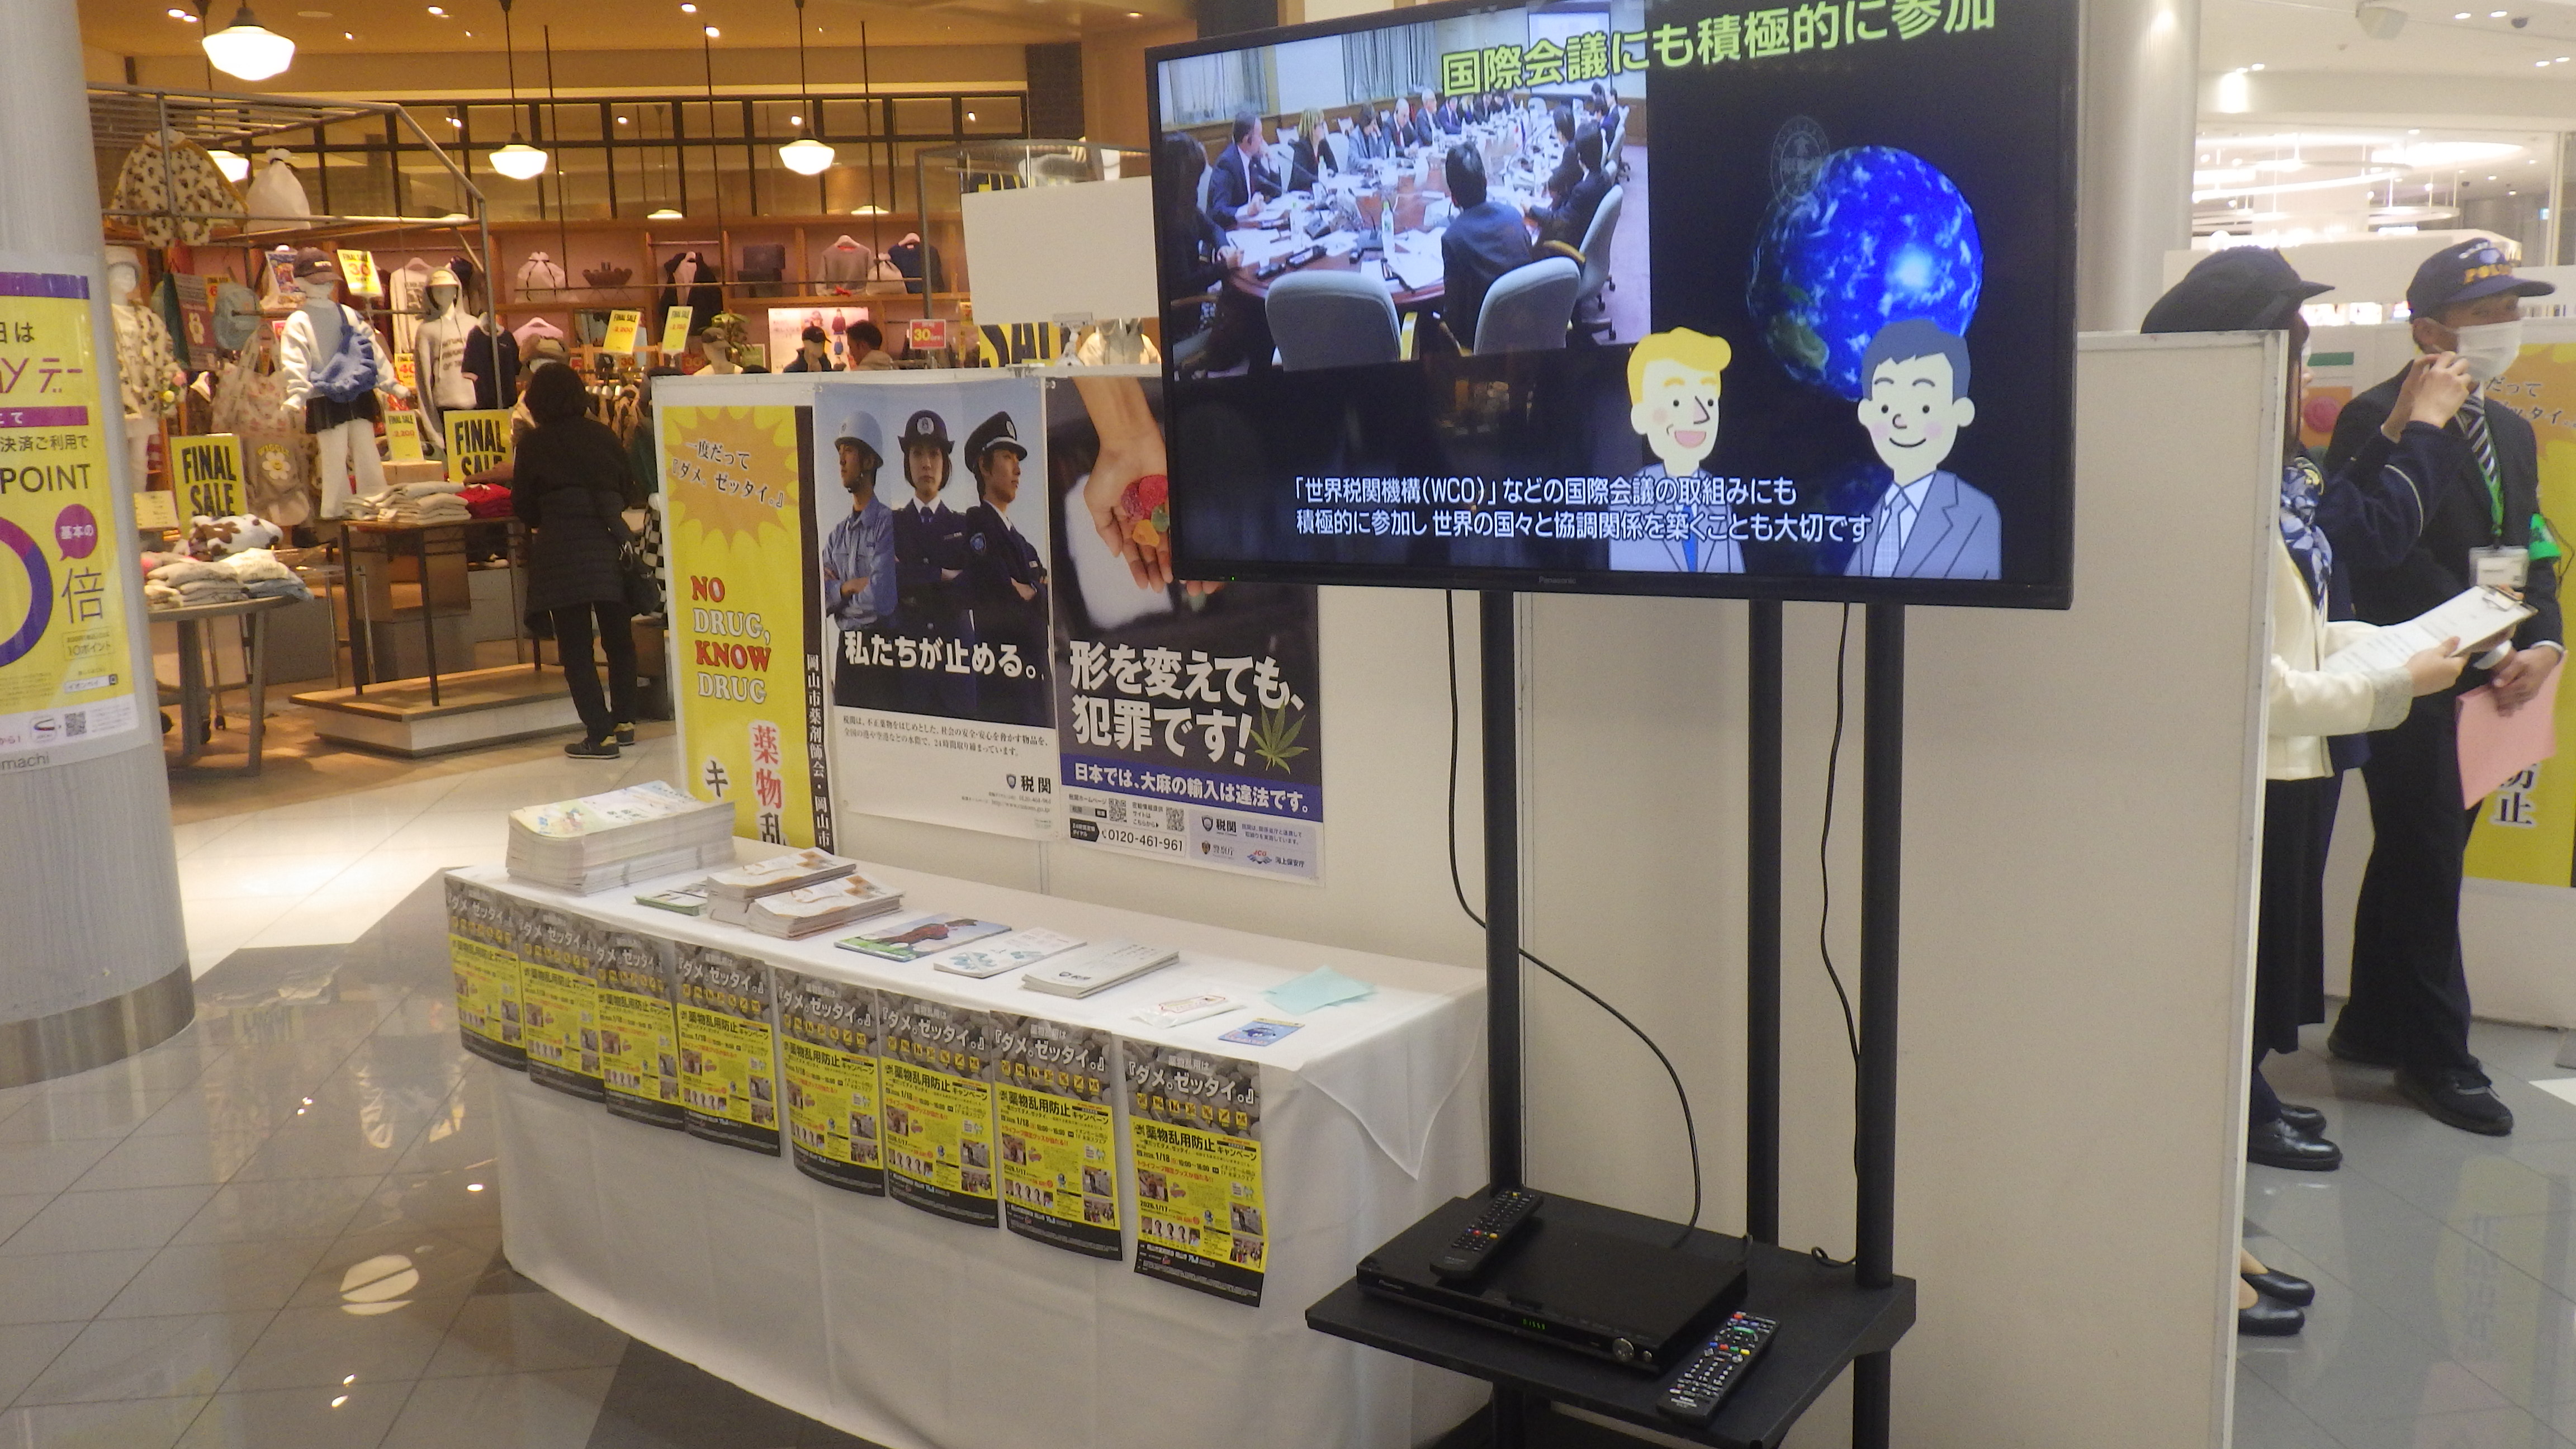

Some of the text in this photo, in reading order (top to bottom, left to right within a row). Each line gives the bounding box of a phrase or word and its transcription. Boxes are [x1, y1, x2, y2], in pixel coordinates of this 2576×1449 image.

[1442, 0, 1995, 97] 国際会議にも積極的に参加
[348, 263, 371, 276] 30
[613, 314, 626, 322] FINAL
[912, 329, 931, 341] 30
[980, 322, 1077, 367] SAL
[2486, 371, 2541, 397] だって
[388, 415, 413, 425] FINAL SALE
[454, 419, 506, 455] FINAL
[181, 445, 237, 484] FINAL
[685, 441, 750, 471] 一度だって
[1, 463, 91, 494] POINT
[190, 482, 236, 516] SALE
[60, 524, 94, 539] 基本の
[1296, 508, 1428, 536] 積極的に参加し
[691, 575, 726, 602] NO
[1538, 576, 1576, 584] Panasonic
[61, 567, 104, 623] 倍
[693, 607, 770, 644] DRUG,
[695, 640, 771, 672] KNOW
[844, 631, 1035, 679] 私たちが止める。
[698, 672, 767, 704] DRUG
[1069, 640, 1304, 711] 形を変えても、
[752, 724, 783, 845] 薬物乱
[1075, 763, 1309, 814] 日本では、大麻の輸入は違法です。
[1216, 818, 1237, 833] 税関
[1109, 829, 1182, 851] 0120-461-961
[1275, 856, 1305, 867] 海上保安庁
[1017, 1116, 1029, 1127] 1/18
[1073, 1111, 1109, 1125] キャンペーン
[1147, 1125, 1215, 1152] 薬物乱用防止
[1156, 1152, 1170, 1163] 1/18
[1216, 1145, 1257, 1161] キャンペーン
